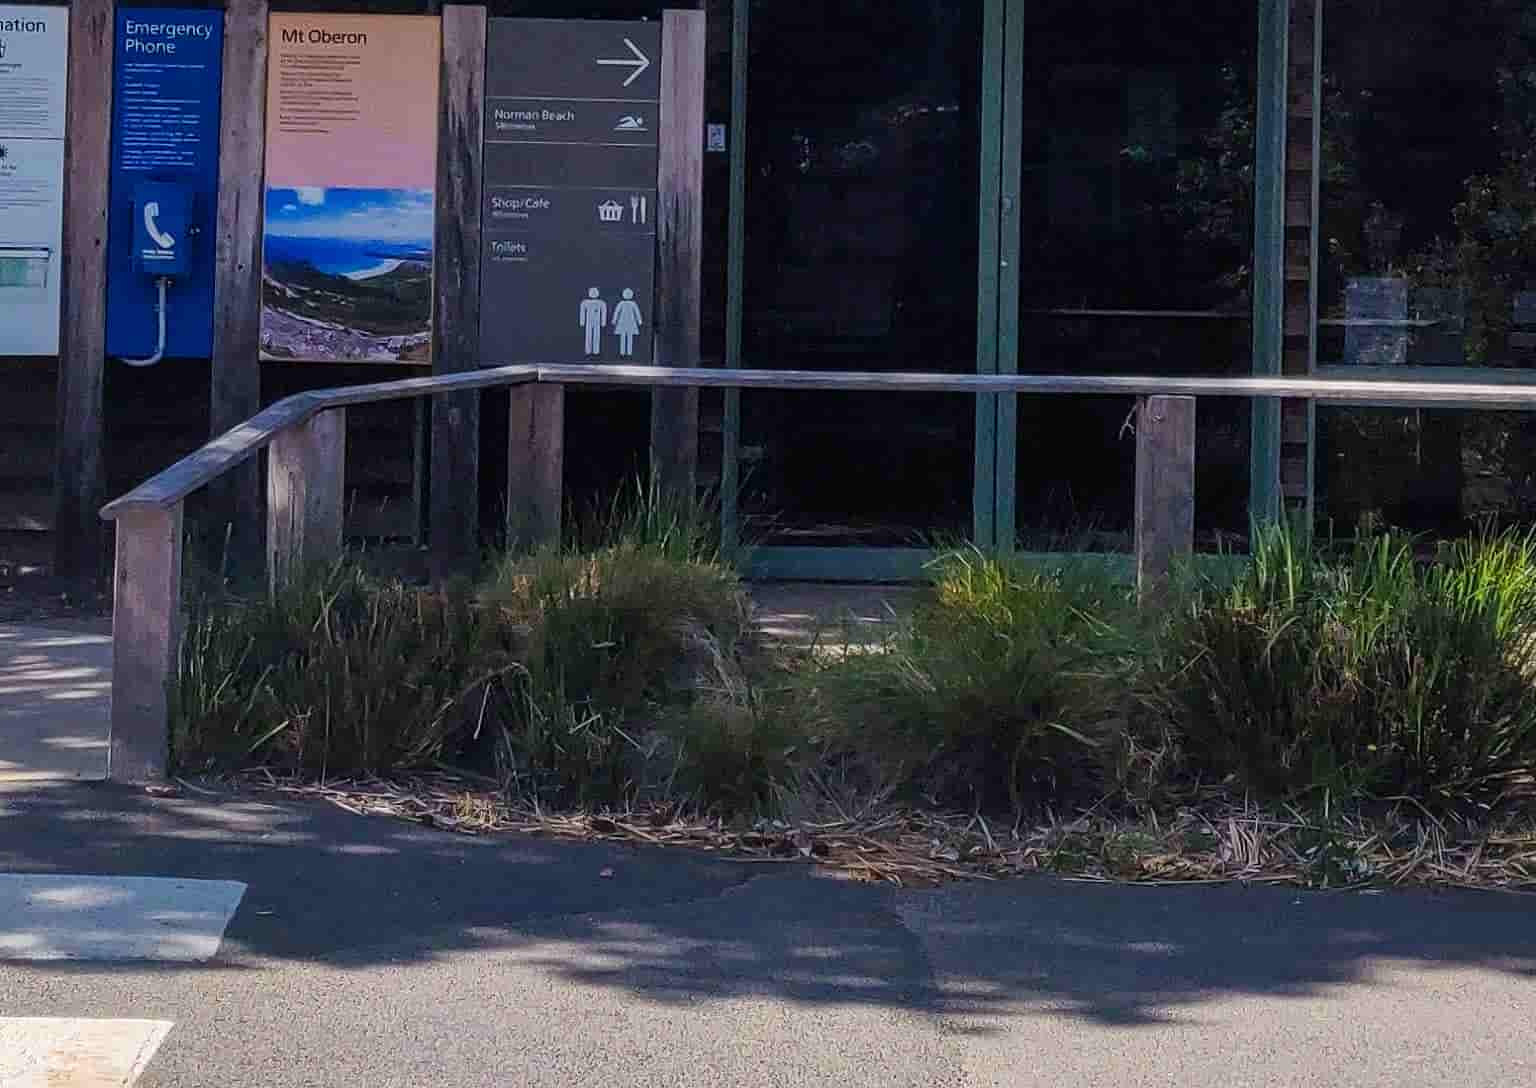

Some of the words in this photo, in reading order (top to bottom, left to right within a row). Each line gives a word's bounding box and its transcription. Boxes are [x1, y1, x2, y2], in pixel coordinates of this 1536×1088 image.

[125, 20, 213, 41] Emergency
[281, 29, 305, 44] Mt
[308, 29, 368, 45] Oberon
[125, 38, 177, 54] Phone
[495, 108, 539, 121] Norman
[542, 108, 575, 121] Beach
